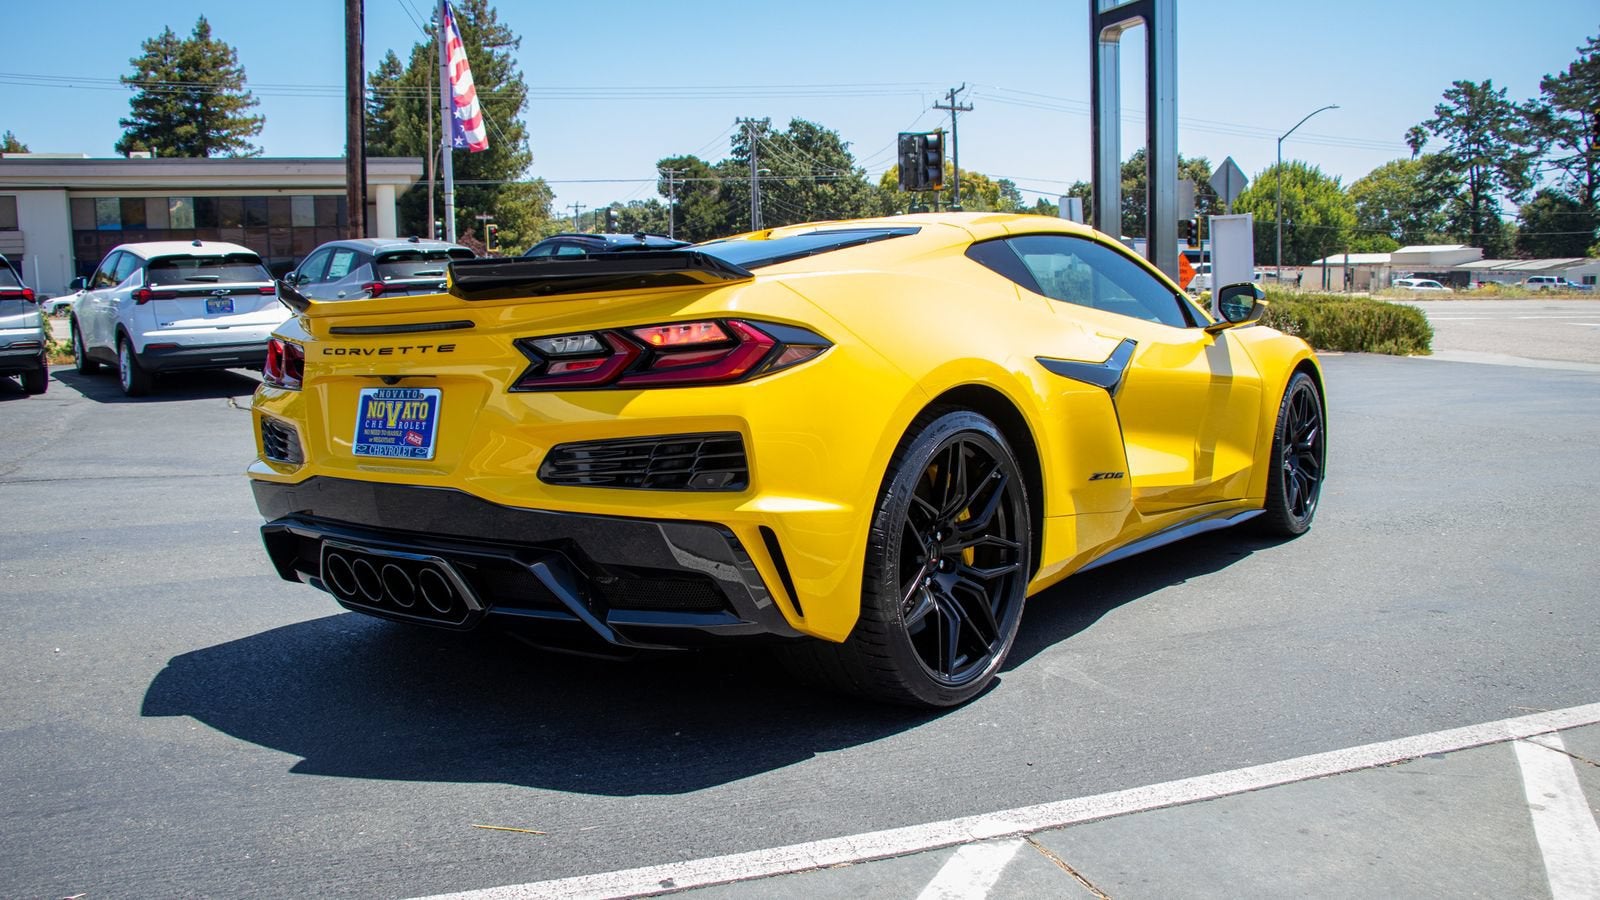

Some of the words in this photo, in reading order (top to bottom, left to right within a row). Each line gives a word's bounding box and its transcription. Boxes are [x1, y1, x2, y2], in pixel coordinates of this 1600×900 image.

[323, 344, 456, 355] CORVETTE
[379, 390, 418, 398] NOVATO
[367, 401, 429, 428] NOVATO
[369, 445, 411, 457] CHEVROLET
[1088, 472, 1124, 480] Z06
